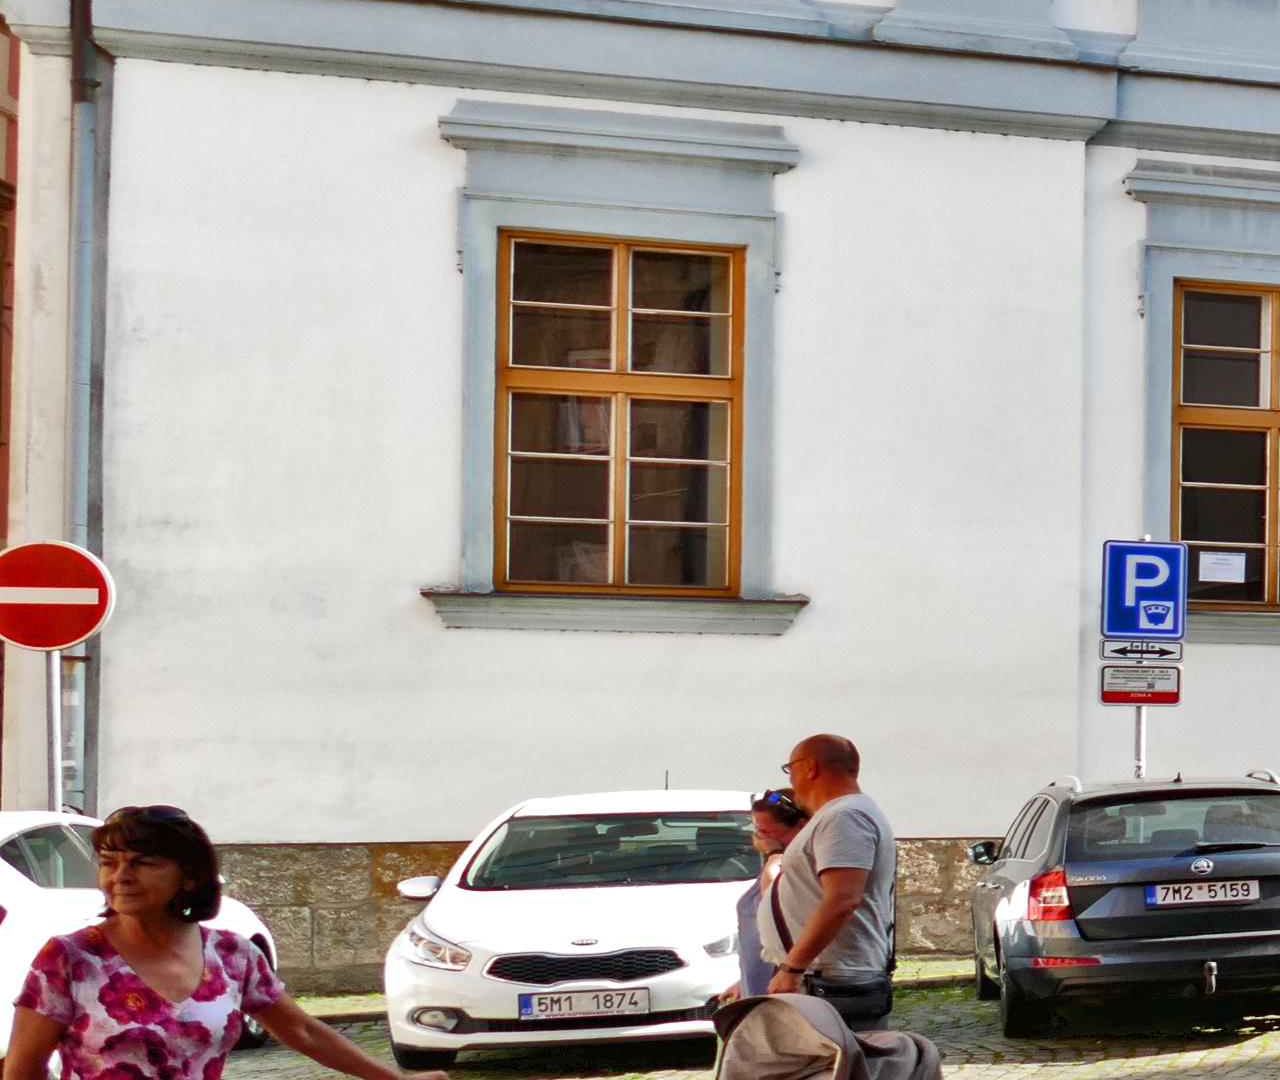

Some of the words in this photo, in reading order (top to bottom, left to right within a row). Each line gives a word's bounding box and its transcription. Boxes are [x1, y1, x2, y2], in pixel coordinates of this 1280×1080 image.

[1124, 554, 1170, 607] P
[1160, 886, 1194, 901] 7M2
[1207, 883, 1250, 899] 5159
[537, 995, 573, 1013] 5M1
[592, 992, 639, 1010] 1874
